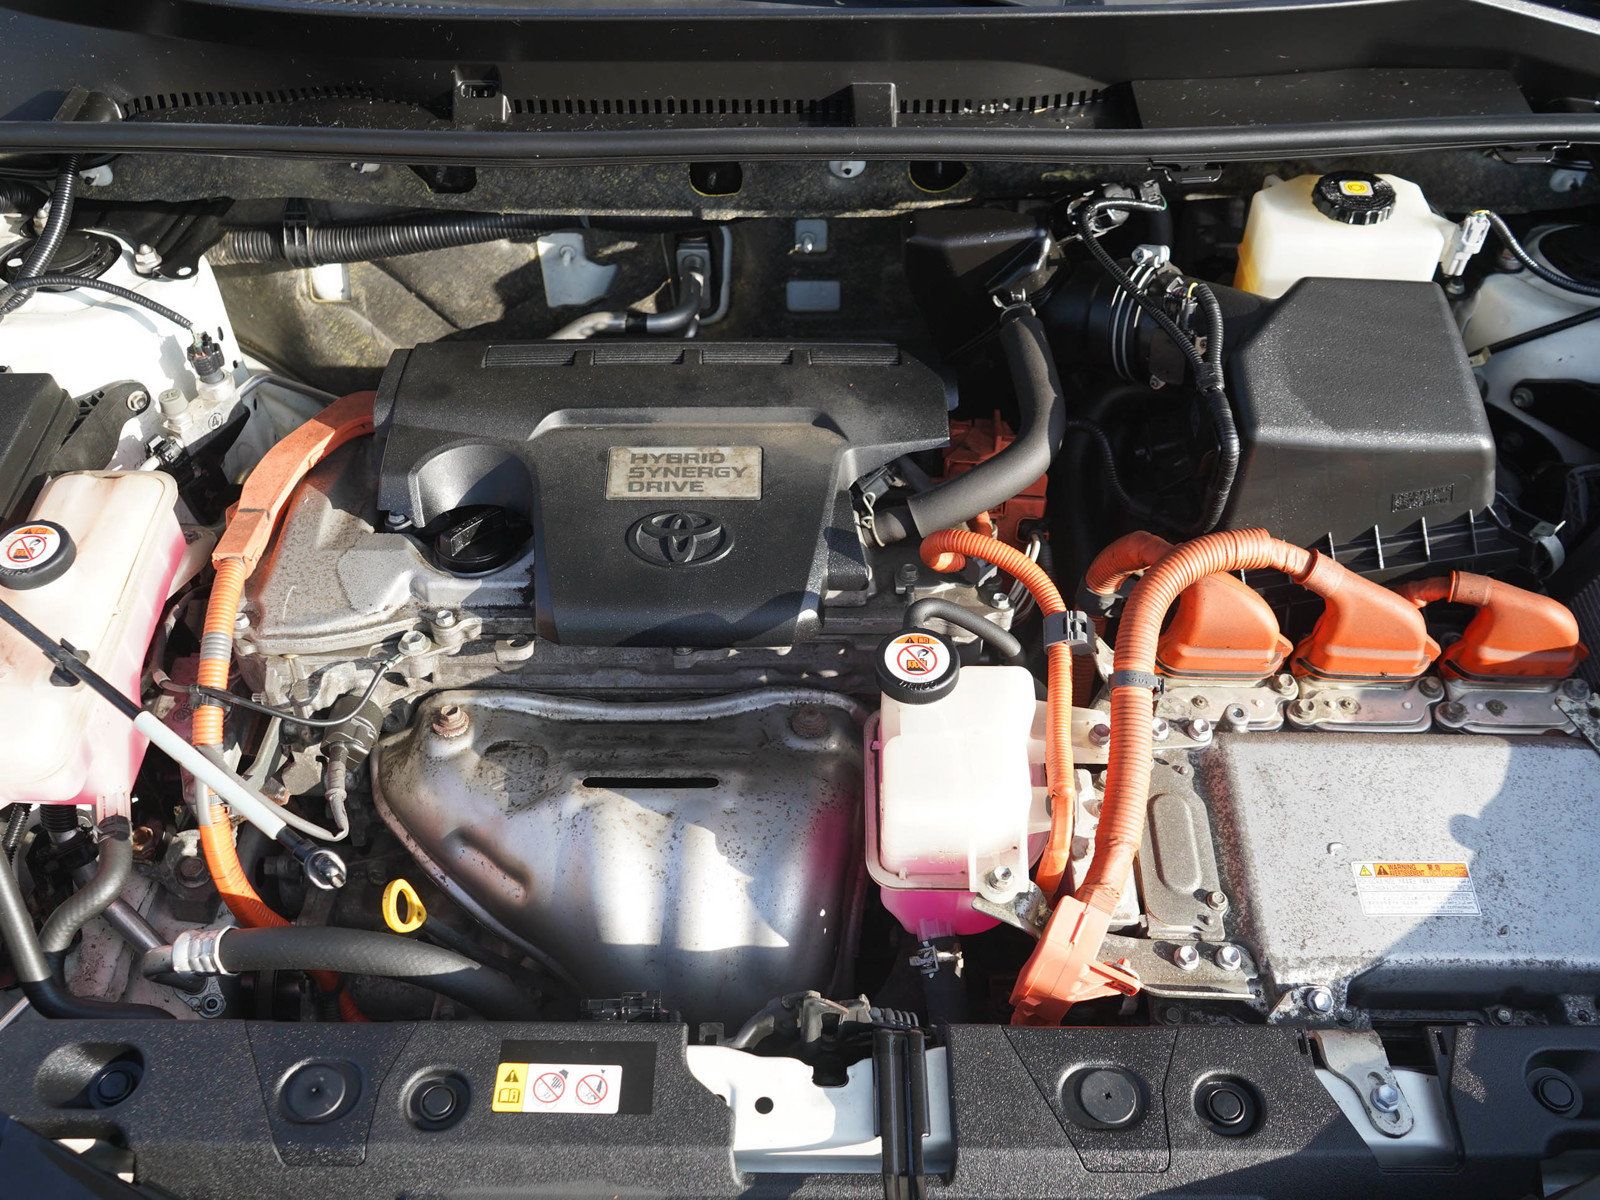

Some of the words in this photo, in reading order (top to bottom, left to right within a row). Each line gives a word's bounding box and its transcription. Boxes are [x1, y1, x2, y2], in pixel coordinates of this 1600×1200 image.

[630, 453, 726, 464] HYBRID
[628, 466, 748, 478] SYNERGY
[627, 480, 704, 493] DRIVE
